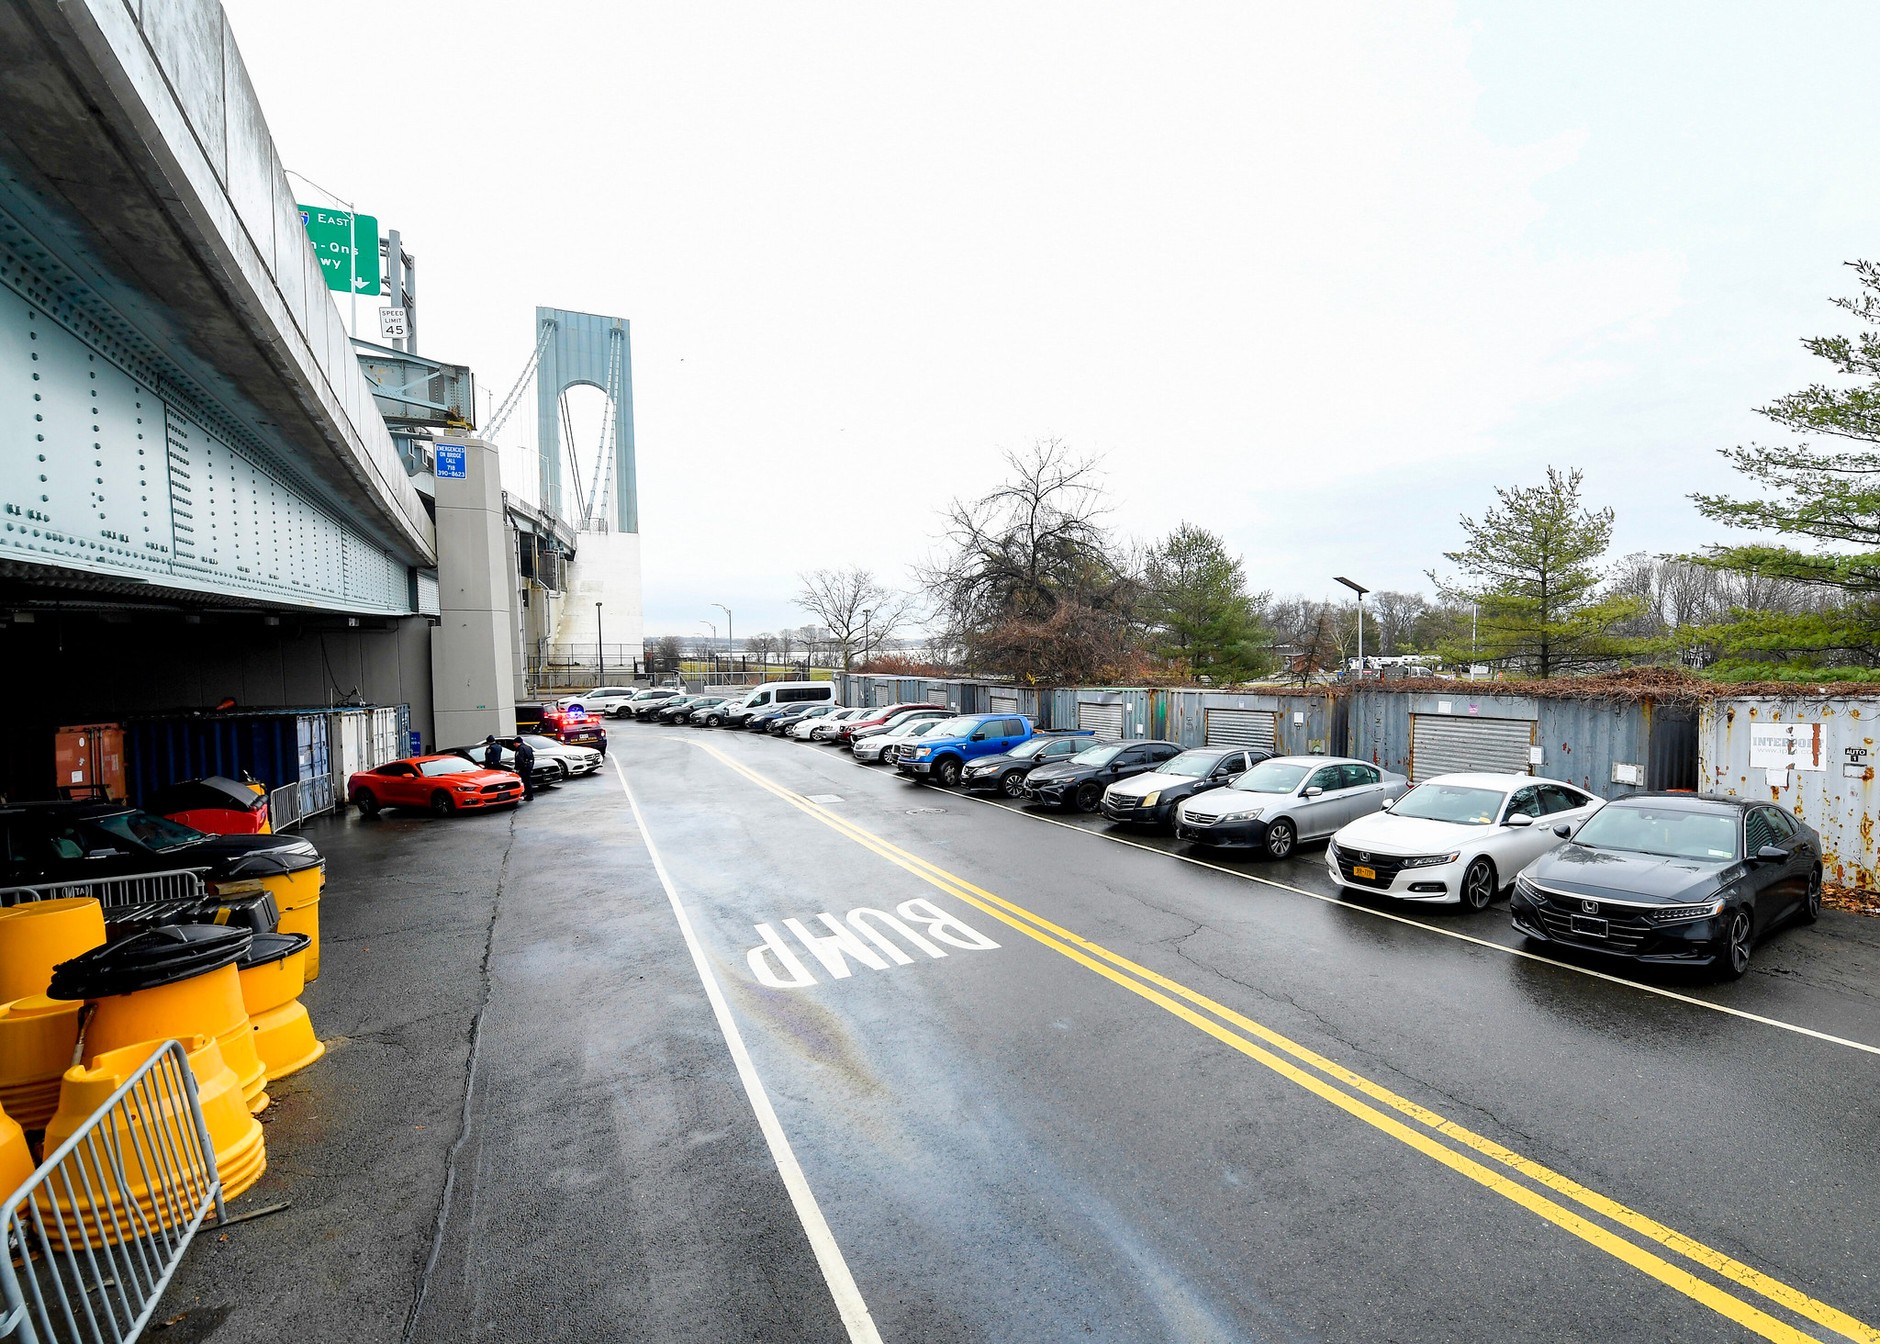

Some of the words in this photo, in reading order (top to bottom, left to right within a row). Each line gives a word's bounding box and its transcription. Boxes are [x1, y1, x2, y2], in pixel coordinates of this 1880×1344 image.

[318, 213, 349, 227] EAST
[386, 325, 404, 335] 45
[747, 898, 1002, 988] BUMP
